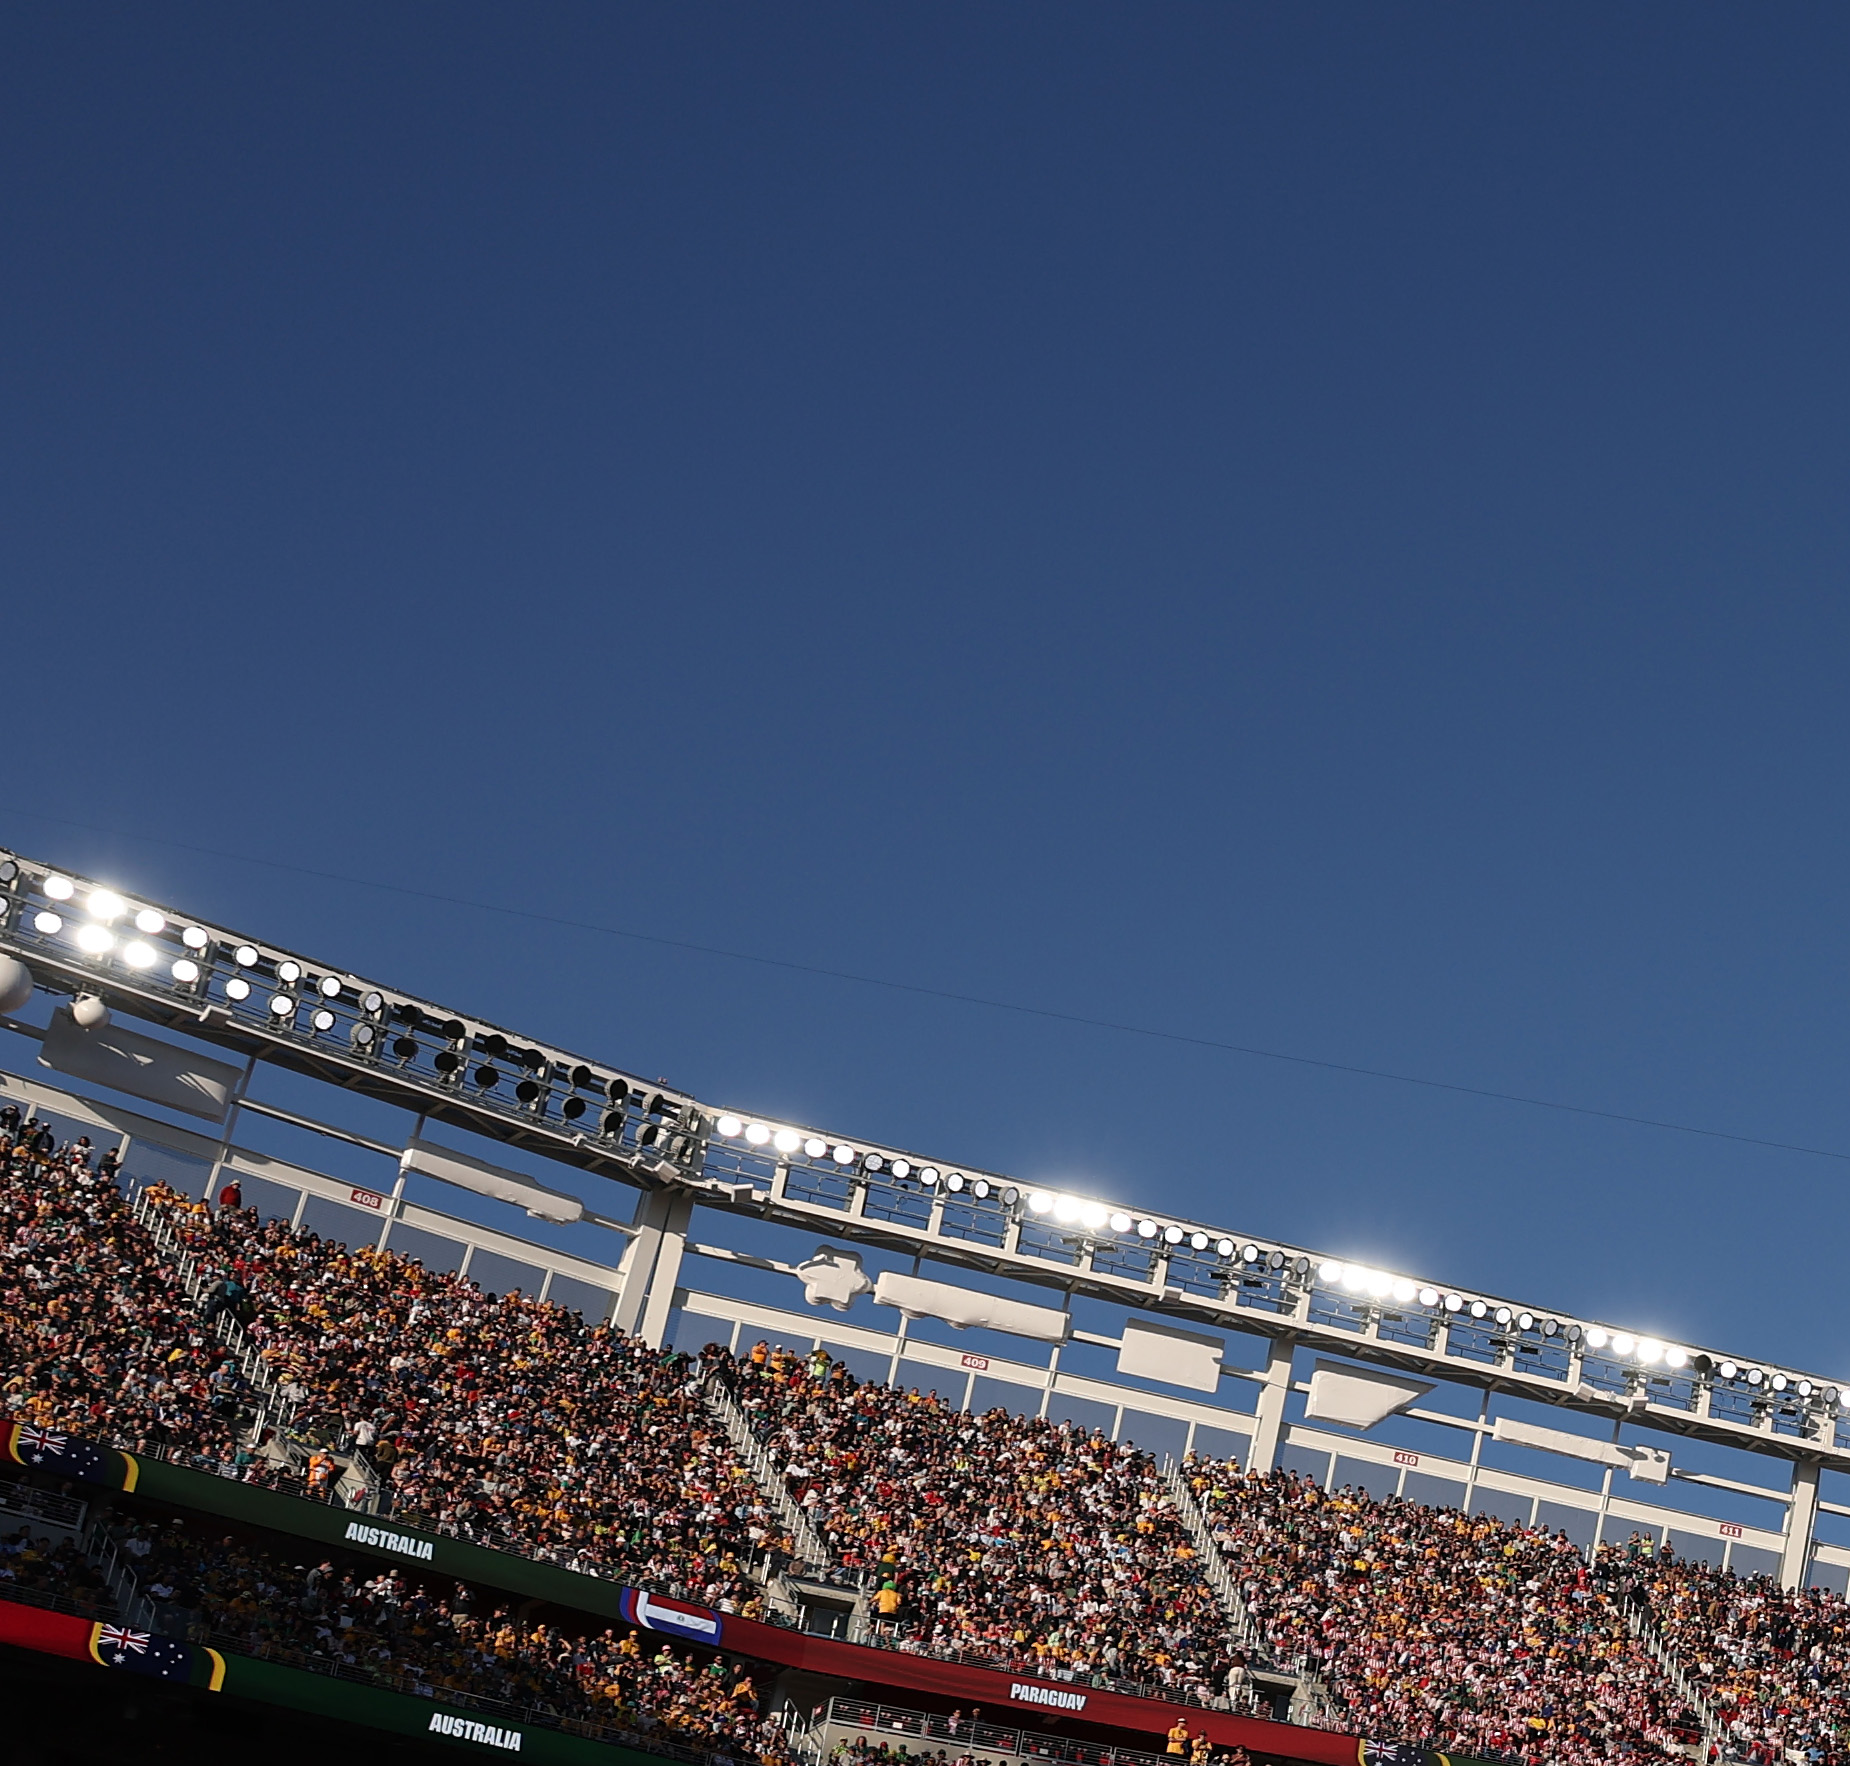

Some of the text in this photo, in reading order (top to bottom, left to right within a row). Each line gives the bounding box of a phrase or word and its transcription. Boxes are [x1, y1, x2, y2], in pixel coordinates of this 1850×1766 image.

[354, 1193, 378, 1207] 408
[963, 1357, 987, 1369] 409
[1396, 1454, 1416, 1464] 410
[1721, 1525, 1740, 1536] 411
[345, 1523, 433, 1560] AUSTRALIA
[1011, 1683, 1086, 1710] PARAGUAY
[429, 1713, 521, 1751] AUSTRALIA
